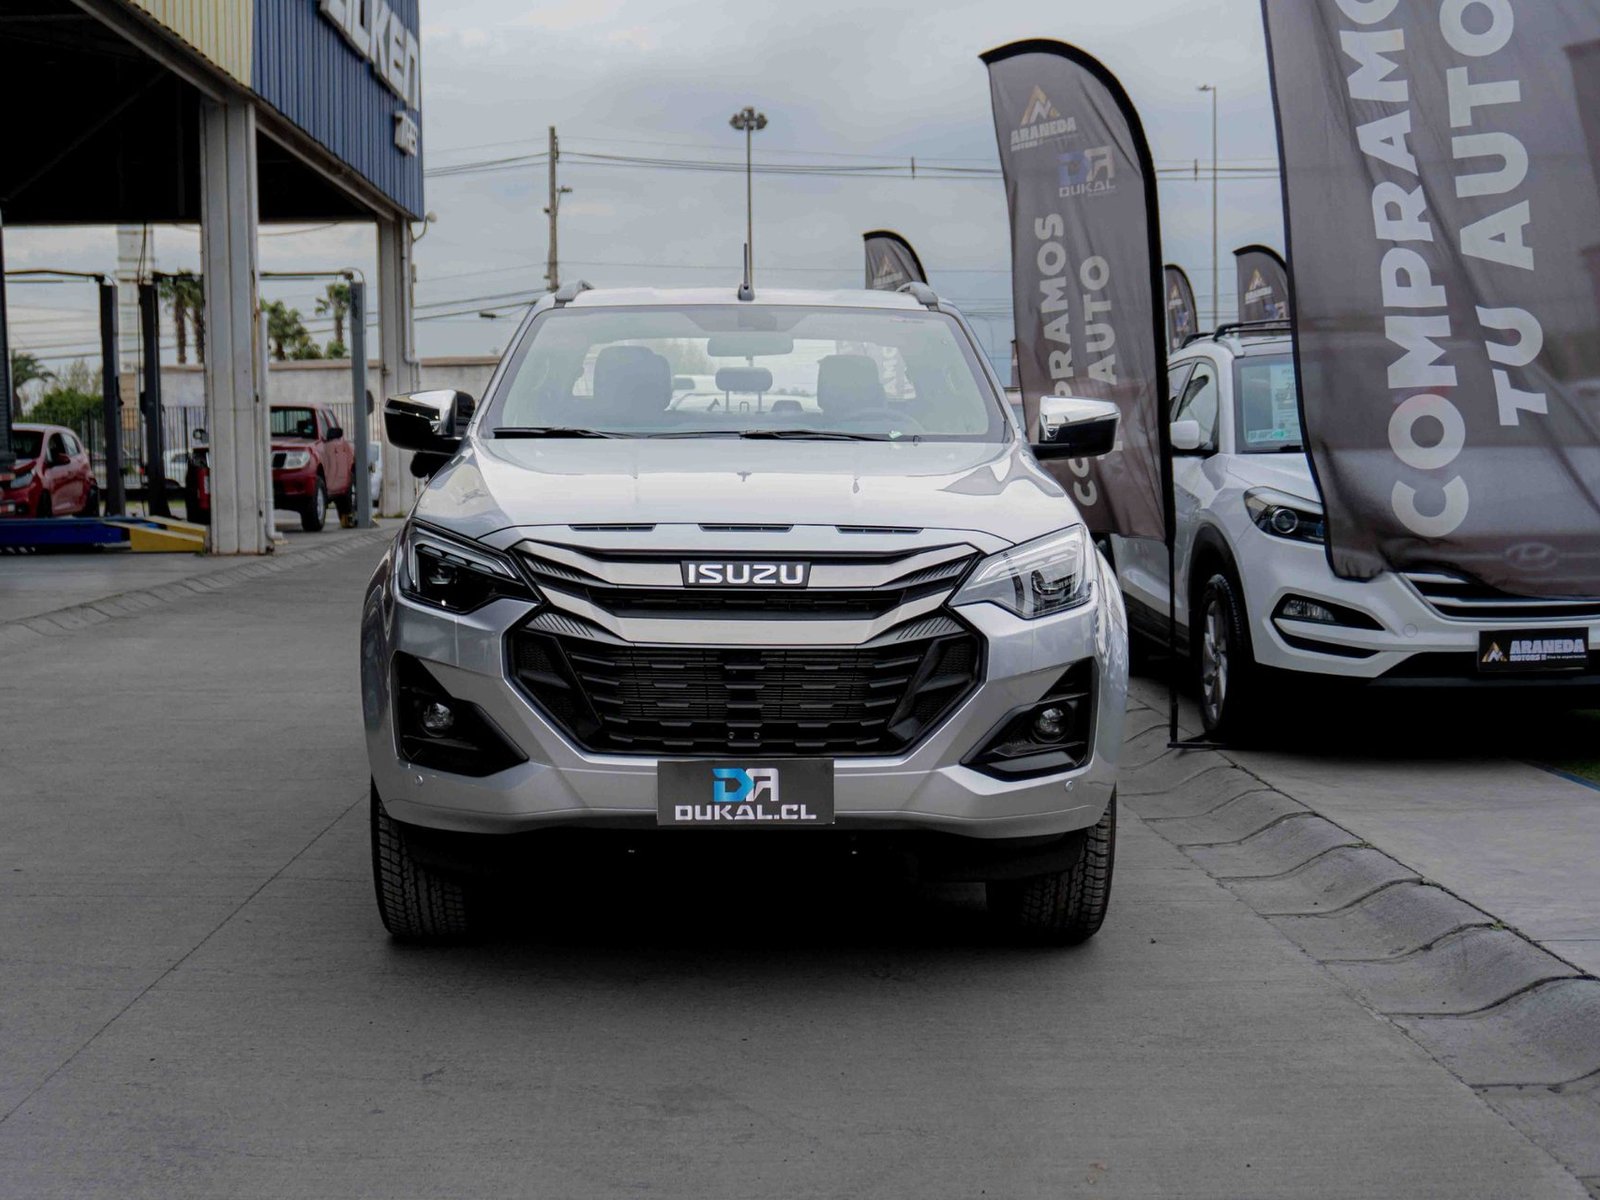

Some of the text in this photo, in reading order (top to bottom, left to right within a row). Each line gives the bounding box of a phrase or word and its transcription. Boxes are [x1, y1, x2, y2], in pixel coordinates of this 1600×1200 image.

[1011, 117, 1077, 146] ARANEDA
[1059, 179, 1117, 198] DUKAL
[1438, 0, 1548, 426] TU AUTO
[1079, 255, 1119, 386] AUTO
[688, 563, 804, 585] ISUZU
[1509, 638, 1585, 653] ARANEDA
[674, 804, 818, 821] DUKAL.CL
